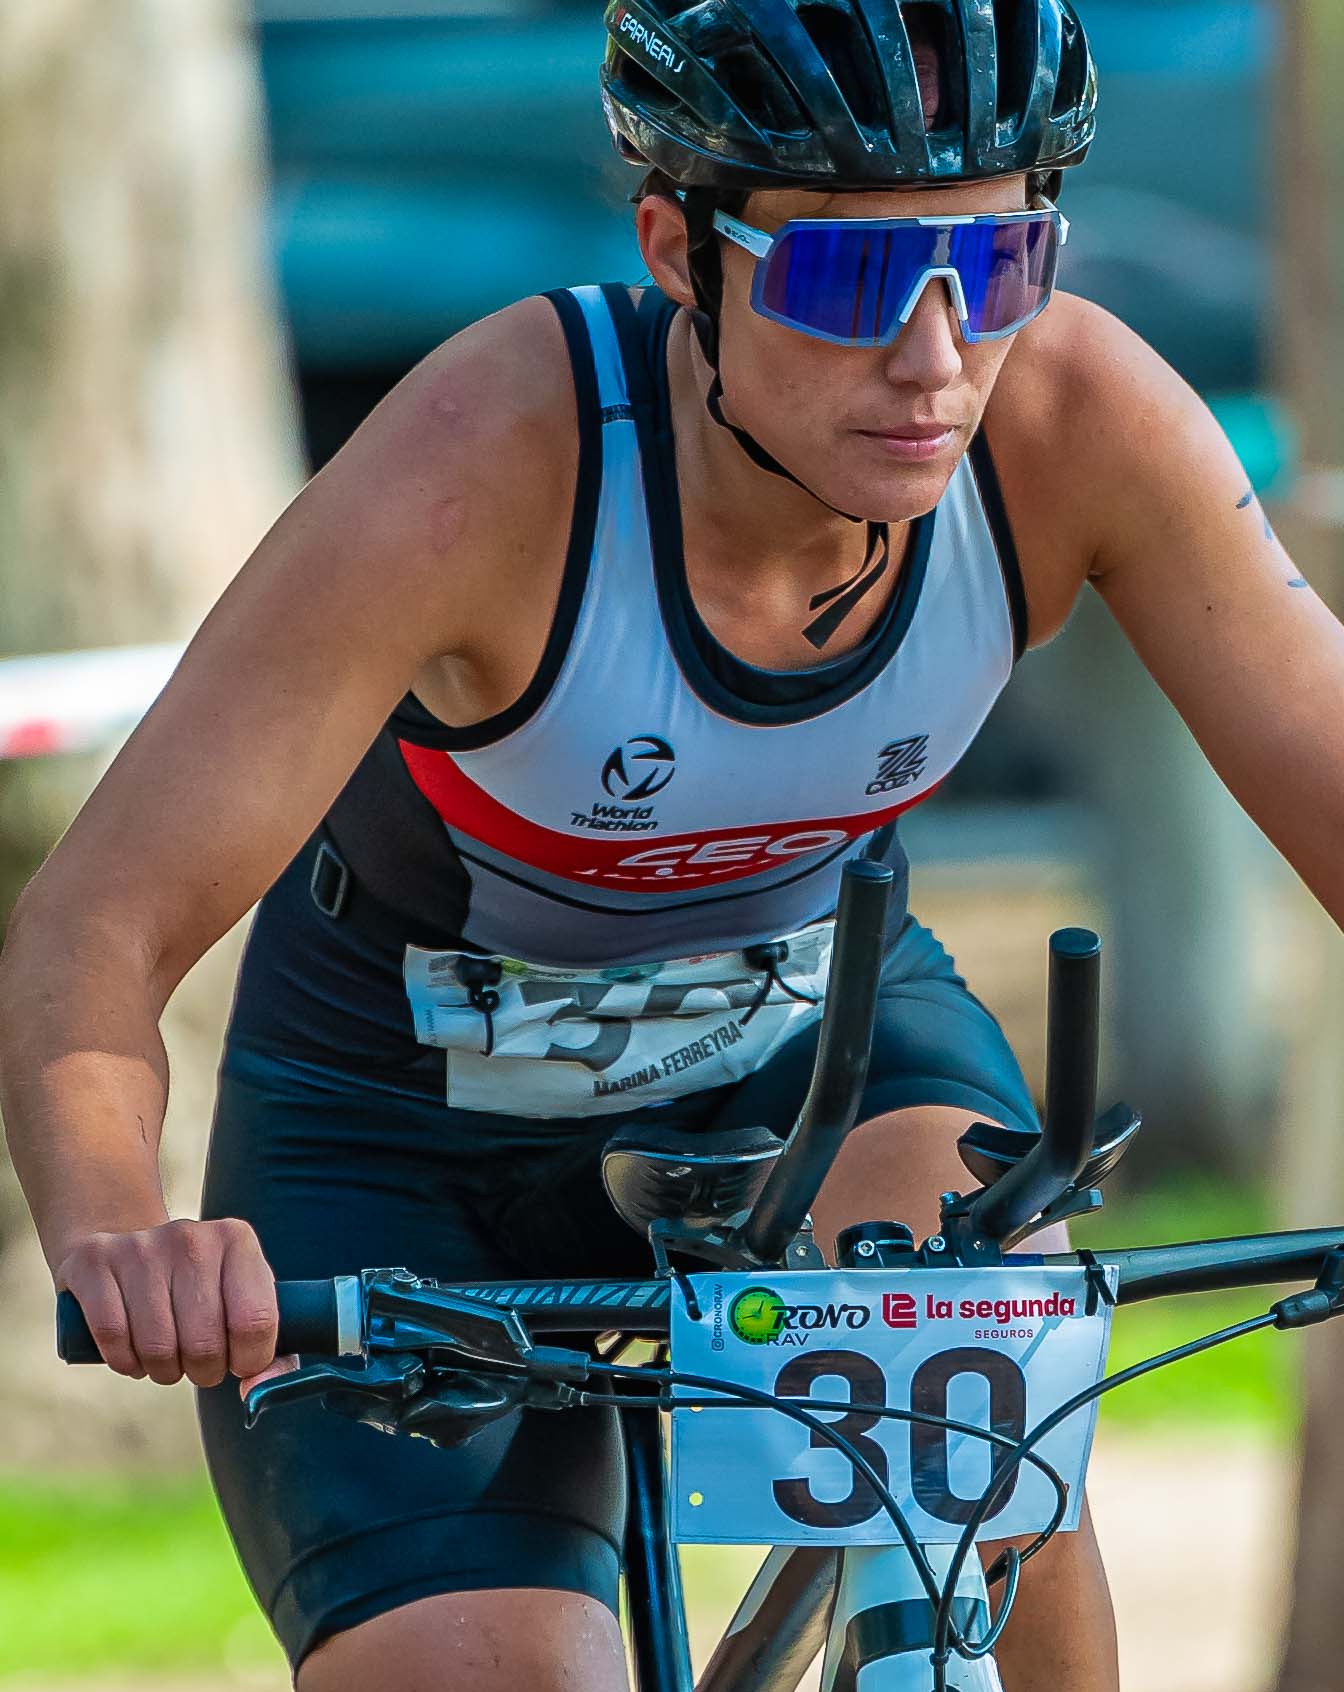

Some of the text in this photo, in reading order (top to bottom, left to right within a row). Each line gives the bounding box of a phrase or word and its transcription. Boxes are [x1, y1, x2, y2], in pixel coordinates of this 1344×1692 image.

[591, 802, 654, 820] World
[570, 812, 659, 833] Triathlon
[661, 1020, 744, 1076] FERREYRA
[926, 1294, 953, 1319] la
[959, 1292, 1076, 1325] segunda
[766, 1332, 810, 1346] RAV
[974, 1329, 1034, 1339] SEGUROS
[772, 1346, 1027, 1529] 30
